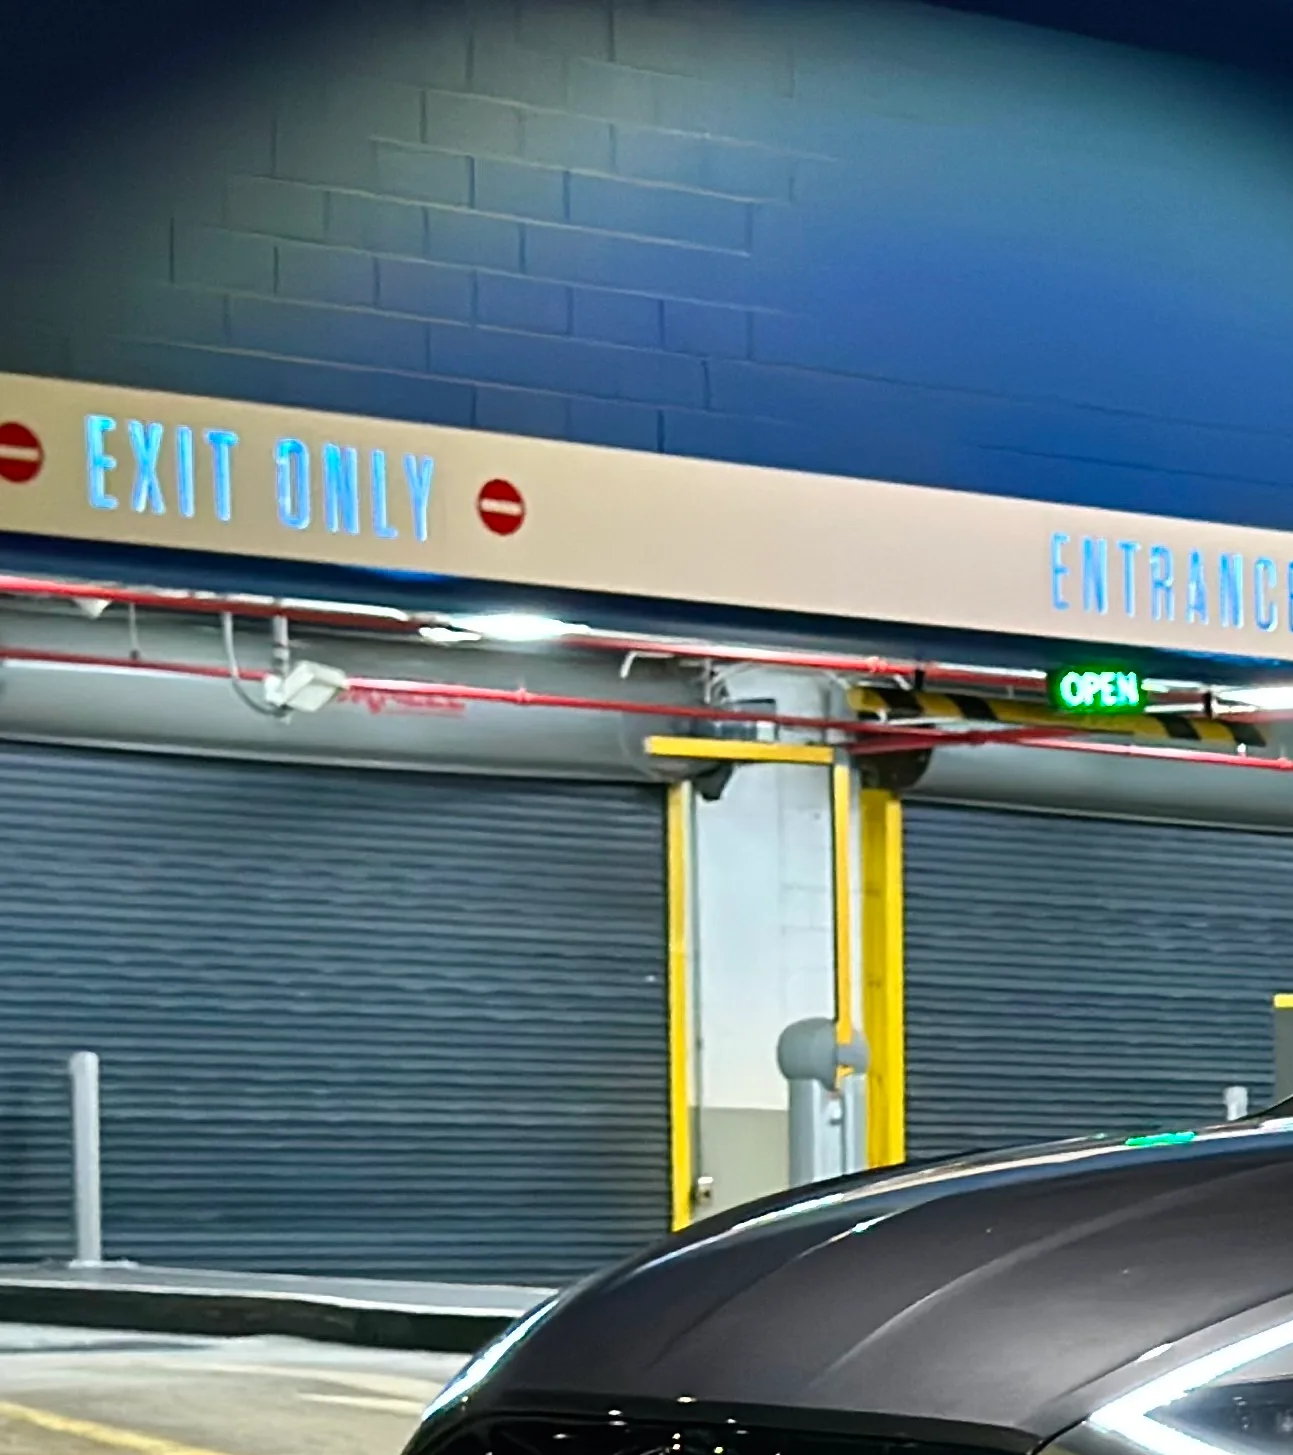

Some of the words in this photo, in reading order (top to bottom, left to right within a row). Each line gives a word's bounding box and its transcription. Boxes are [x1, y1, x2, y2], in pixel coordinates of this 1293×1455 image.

[84, 414, 239, 521] EXIT
[275, 436, 434, 542] ONLY
[1059, 671, 1140, 706] OPEN
